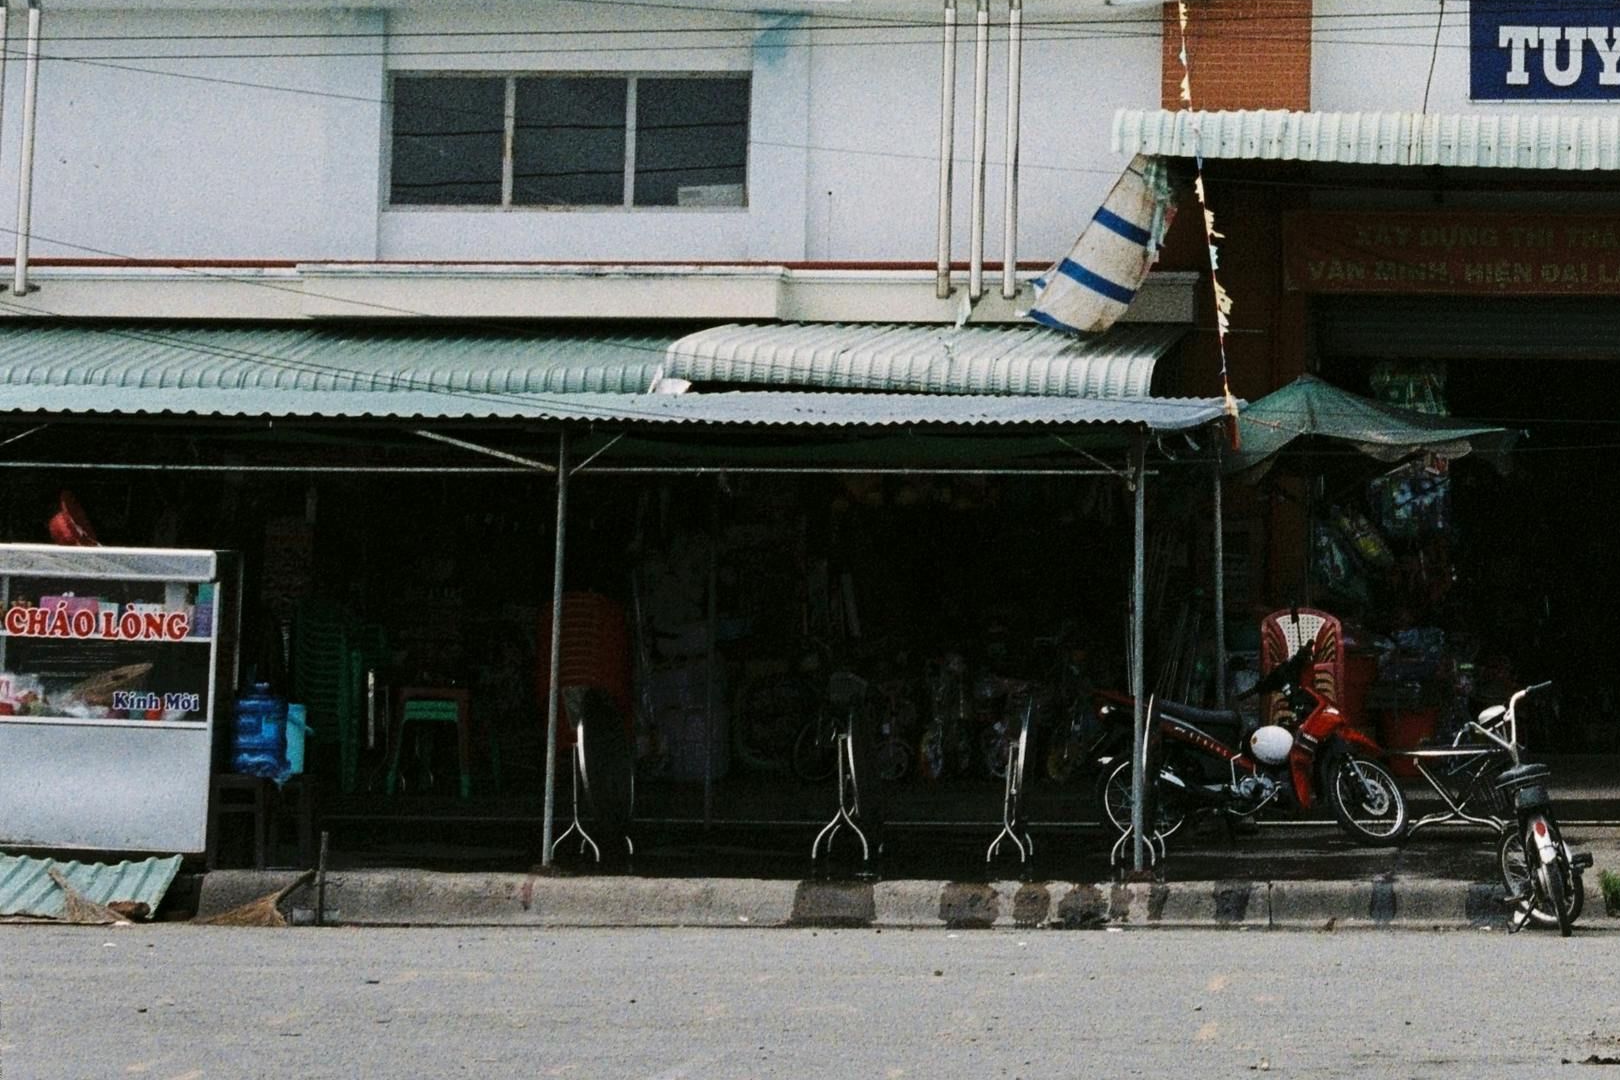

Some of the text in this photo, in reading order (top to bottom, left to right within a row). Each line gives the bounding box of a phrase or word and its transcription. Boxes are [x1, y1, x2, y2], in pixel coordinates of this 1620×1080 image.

[5, 600, 189, 642] CHÁO LÒNG
[112, 690, 200, 712] Kính Mời
